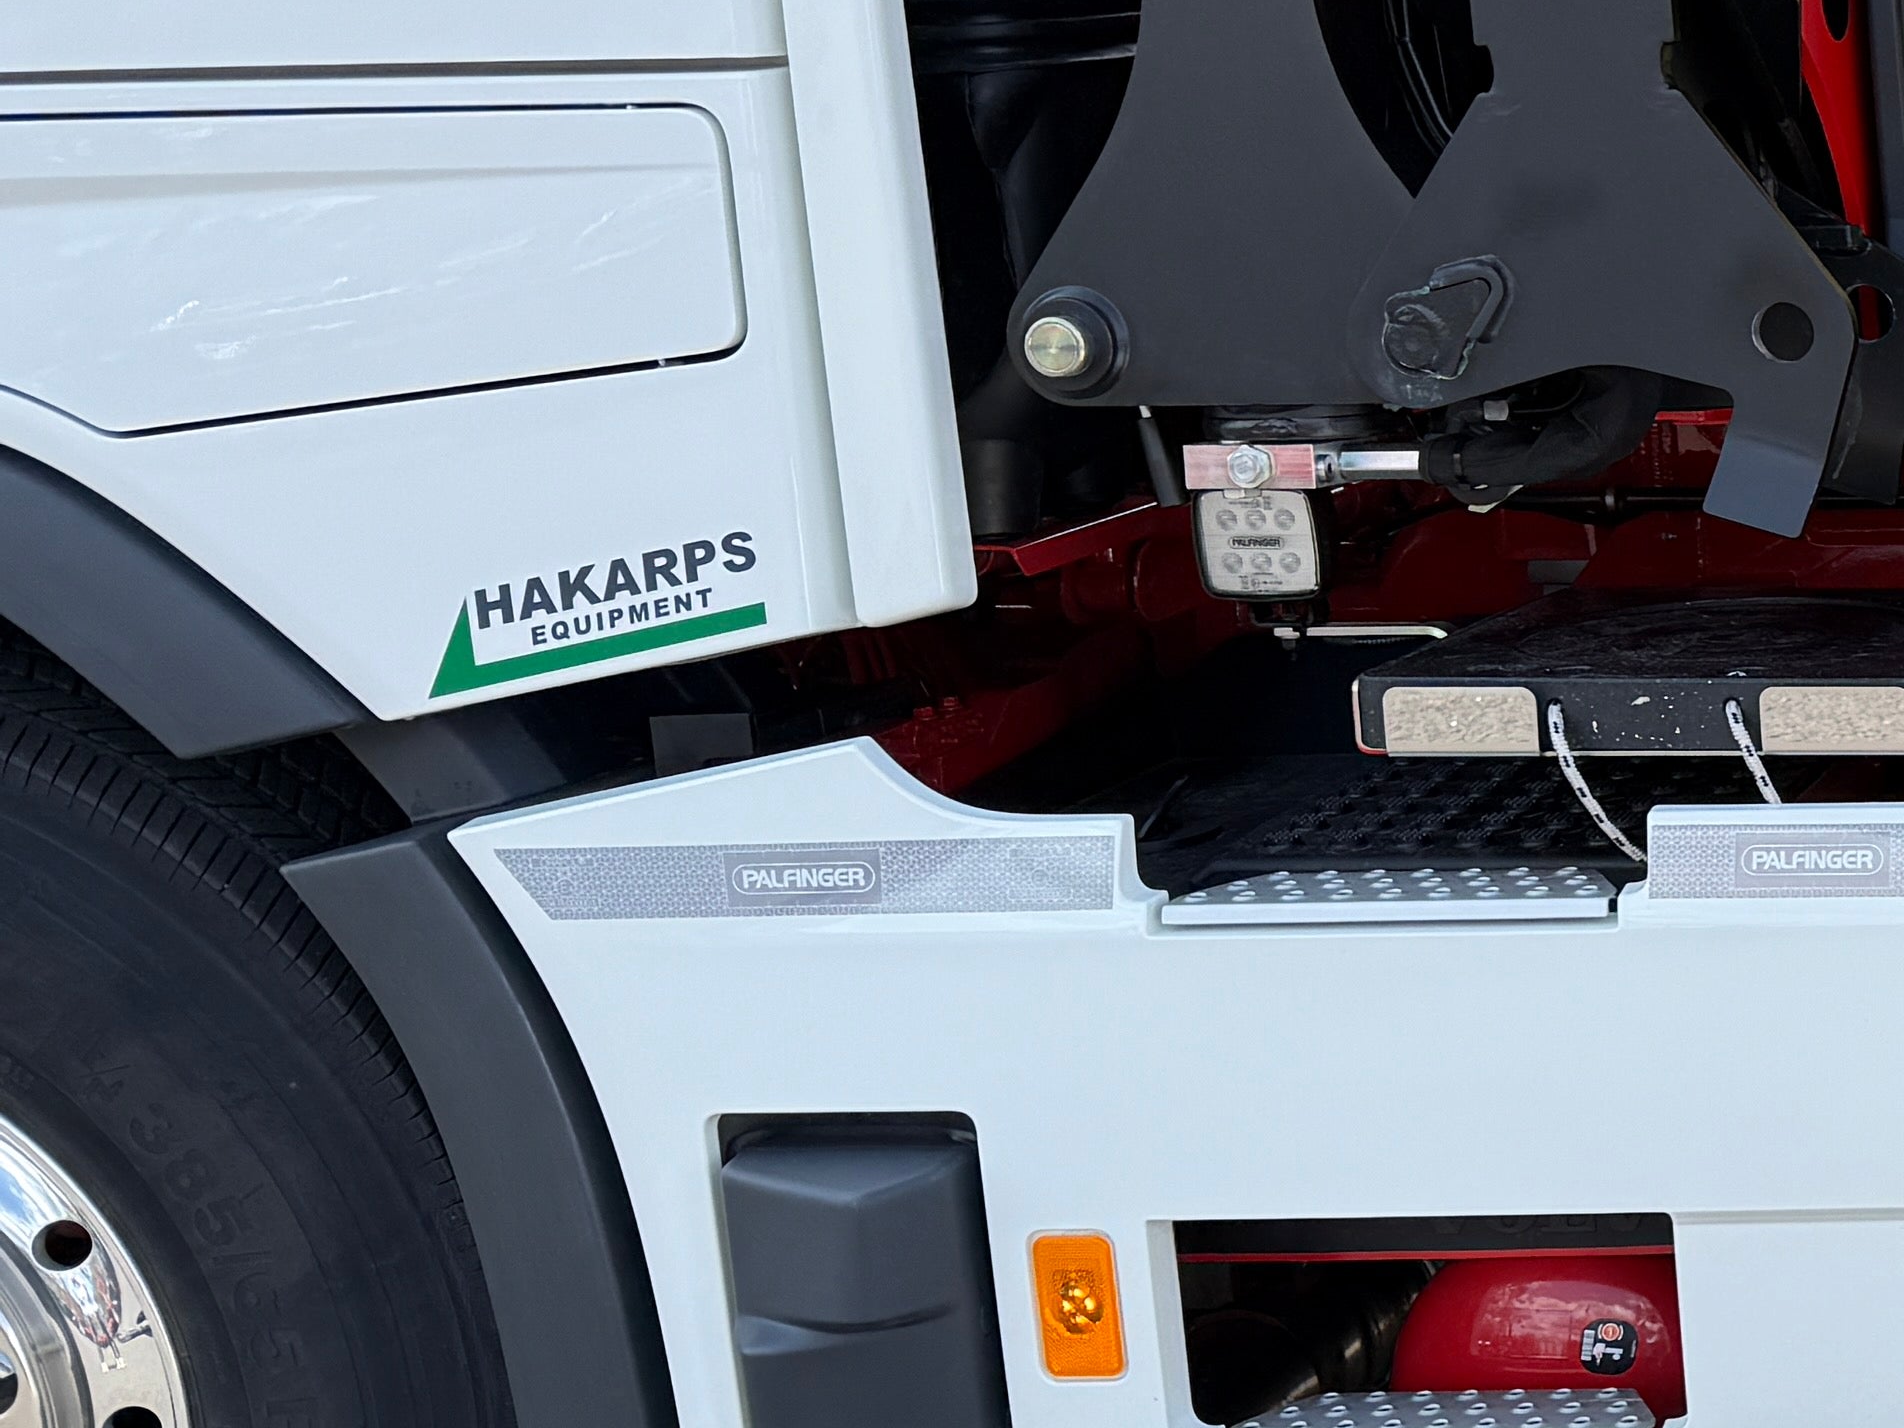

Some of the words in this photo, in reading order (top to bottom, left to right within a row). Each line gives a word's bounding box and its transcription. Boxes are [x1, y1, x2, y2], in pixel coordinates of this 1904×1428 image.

[476, 530, 758, 631] HAKARPS
[530, 588, 713, 646] EQUIPMENT
[742, 867, 866, 890] PALFINGER
[1750, 850, 1874, 870] PALFINGER
[129, 1102, 305, 1374] 385/65
